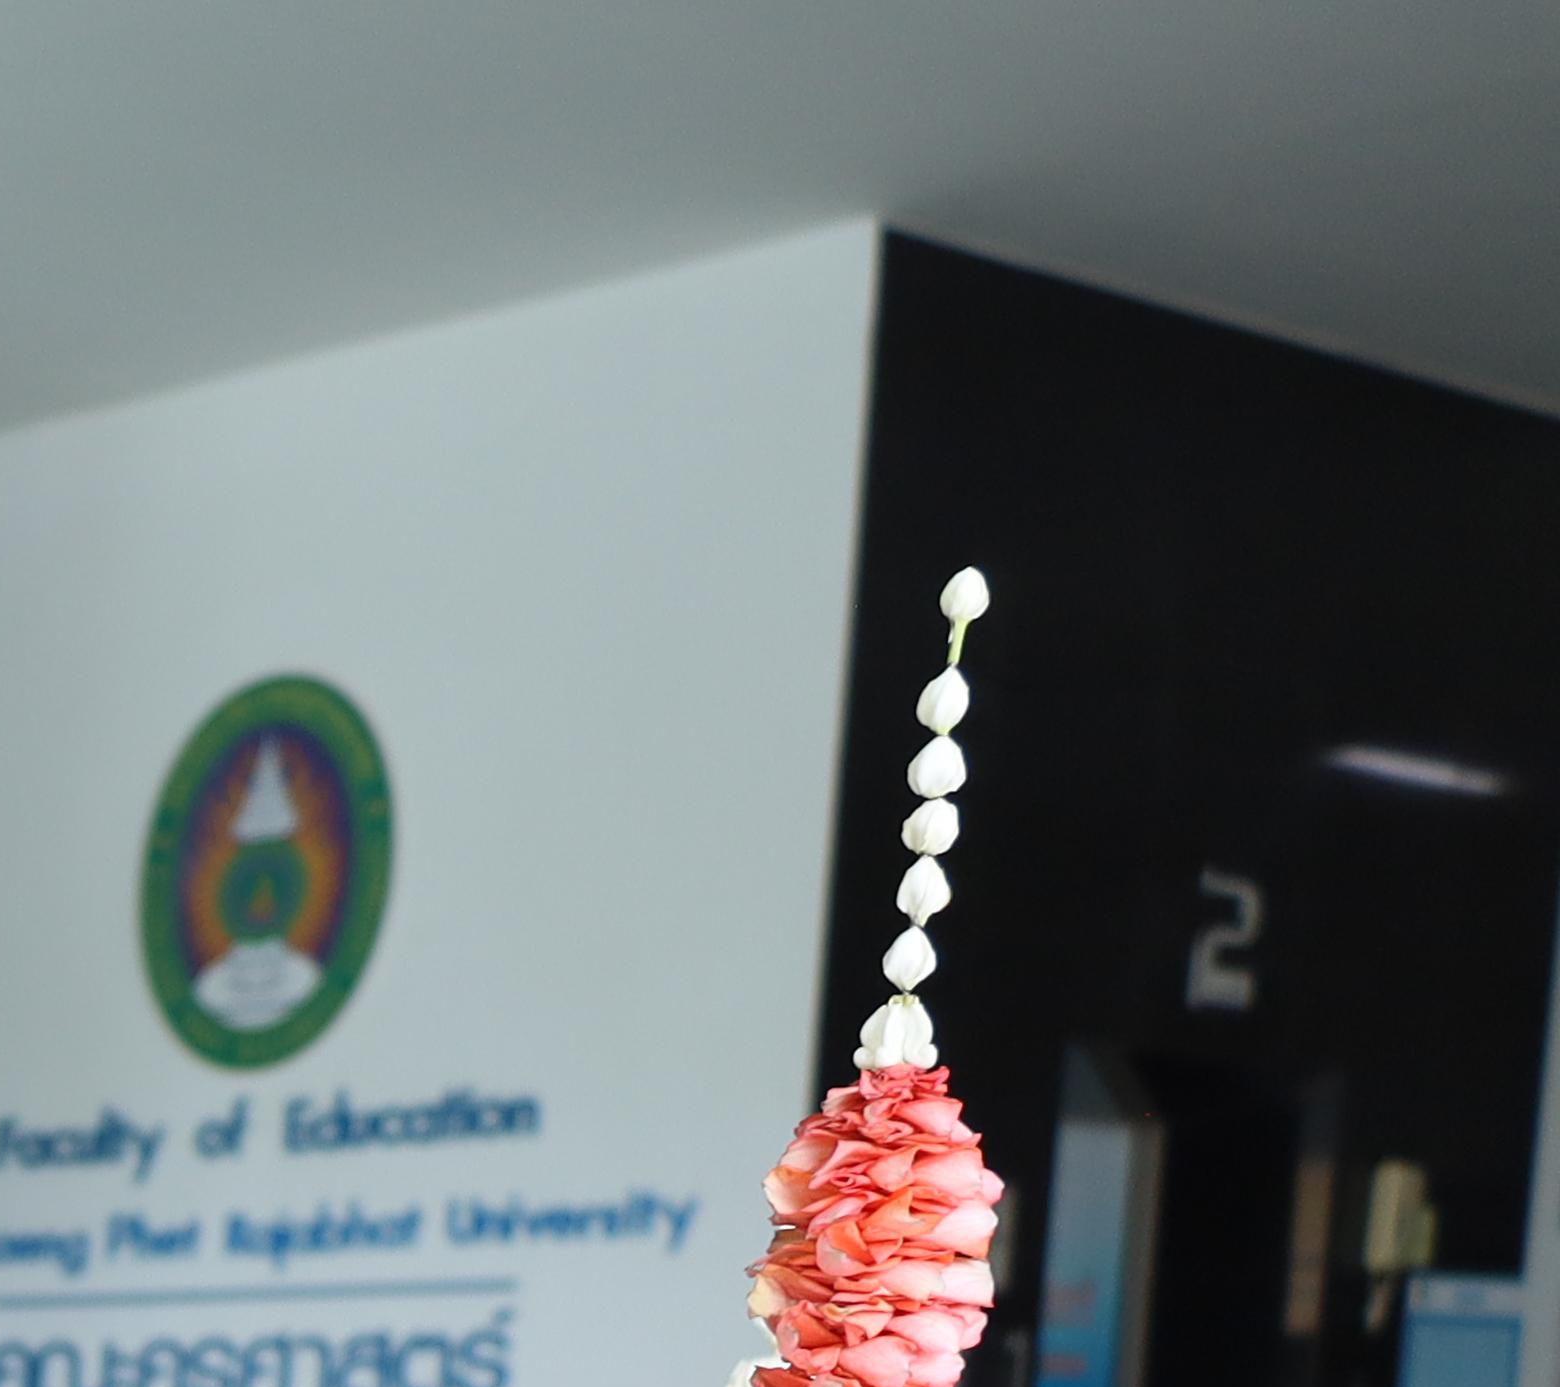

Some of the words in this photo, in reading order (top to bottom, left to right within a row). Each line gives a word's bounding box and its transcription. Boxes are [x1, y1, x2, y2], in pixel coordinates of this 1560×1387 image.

[1186, 864, 1264, 1010] 2
[195, 1096, 249, 1158] of
[284, 1088, 540, 1154] Education
[447, 1187, 697, 1254] University
